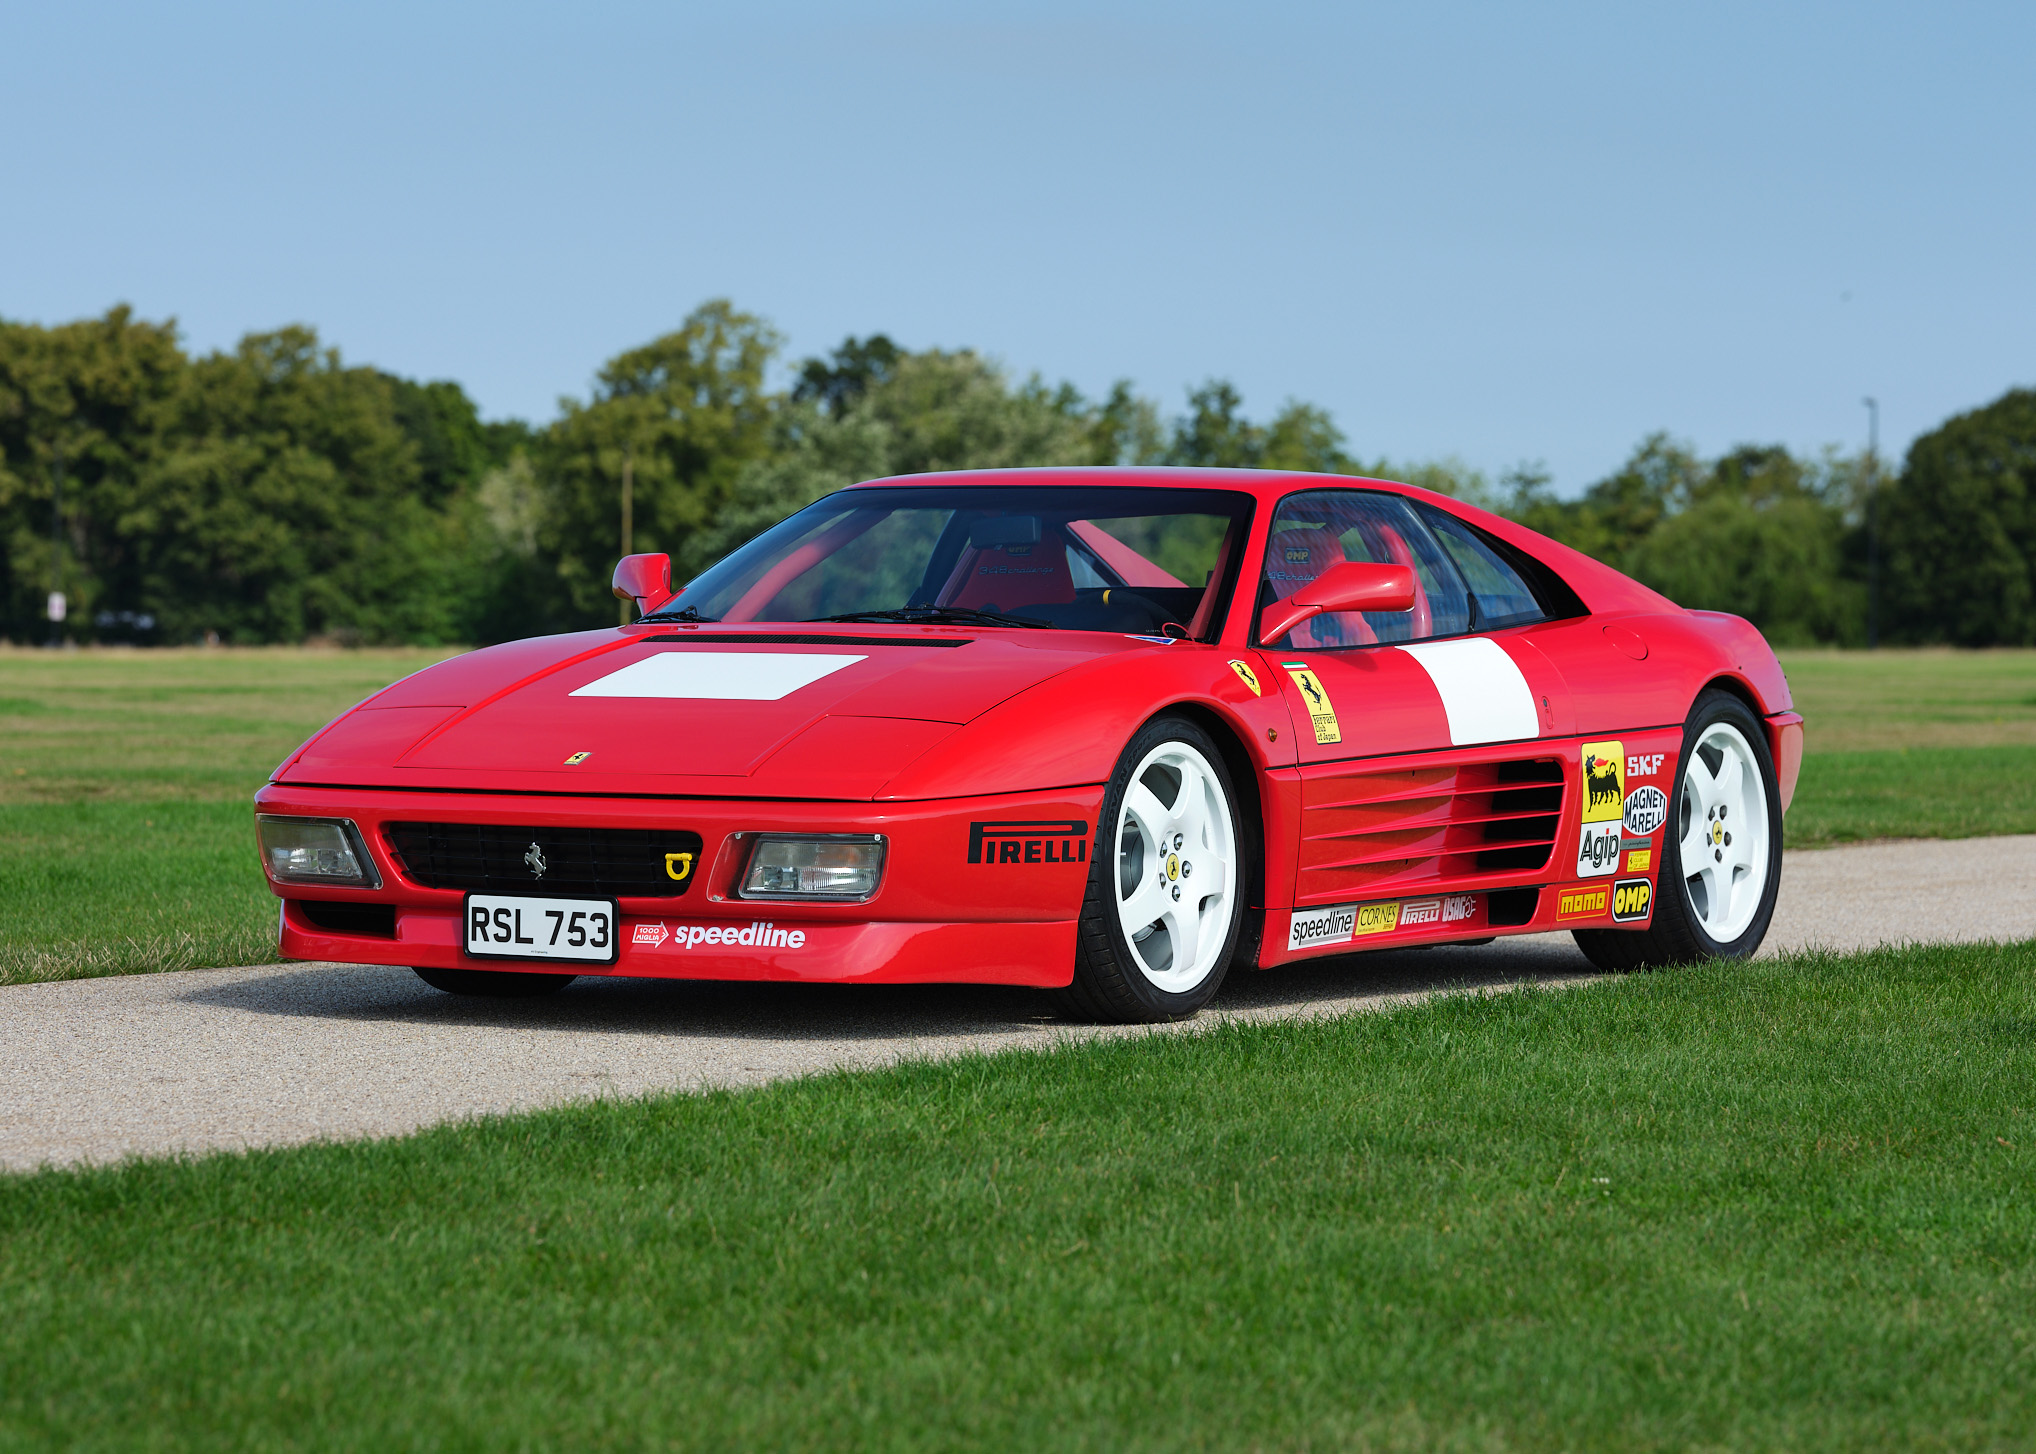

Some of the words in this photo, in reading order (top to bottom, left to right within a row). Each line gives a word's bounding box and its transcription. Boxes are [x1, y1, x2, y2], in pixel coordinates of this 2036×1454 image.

[1286, 551, 1309, 561] OMP
[1627, 754, 1665, 777] SKF
[1624, 788, 1666, 814] MAGNETI
[1624, 808, 1665, 833] MARELLI
[967, 820, 1089, 864] PIRELLI
[1579, 827, 1620, 869] Agip
[1614, 885, 1650, 914] OMP
[471, 906, 534, 944] RSL
[545, 910, 609, 948] 753
[1360, 905, 1397, 926] CORNES
[1400, 901, 1441, 926] PIRELLI
[674, 922, 806, 950] speedline
[1293, 910, 1352, 946] speedline
